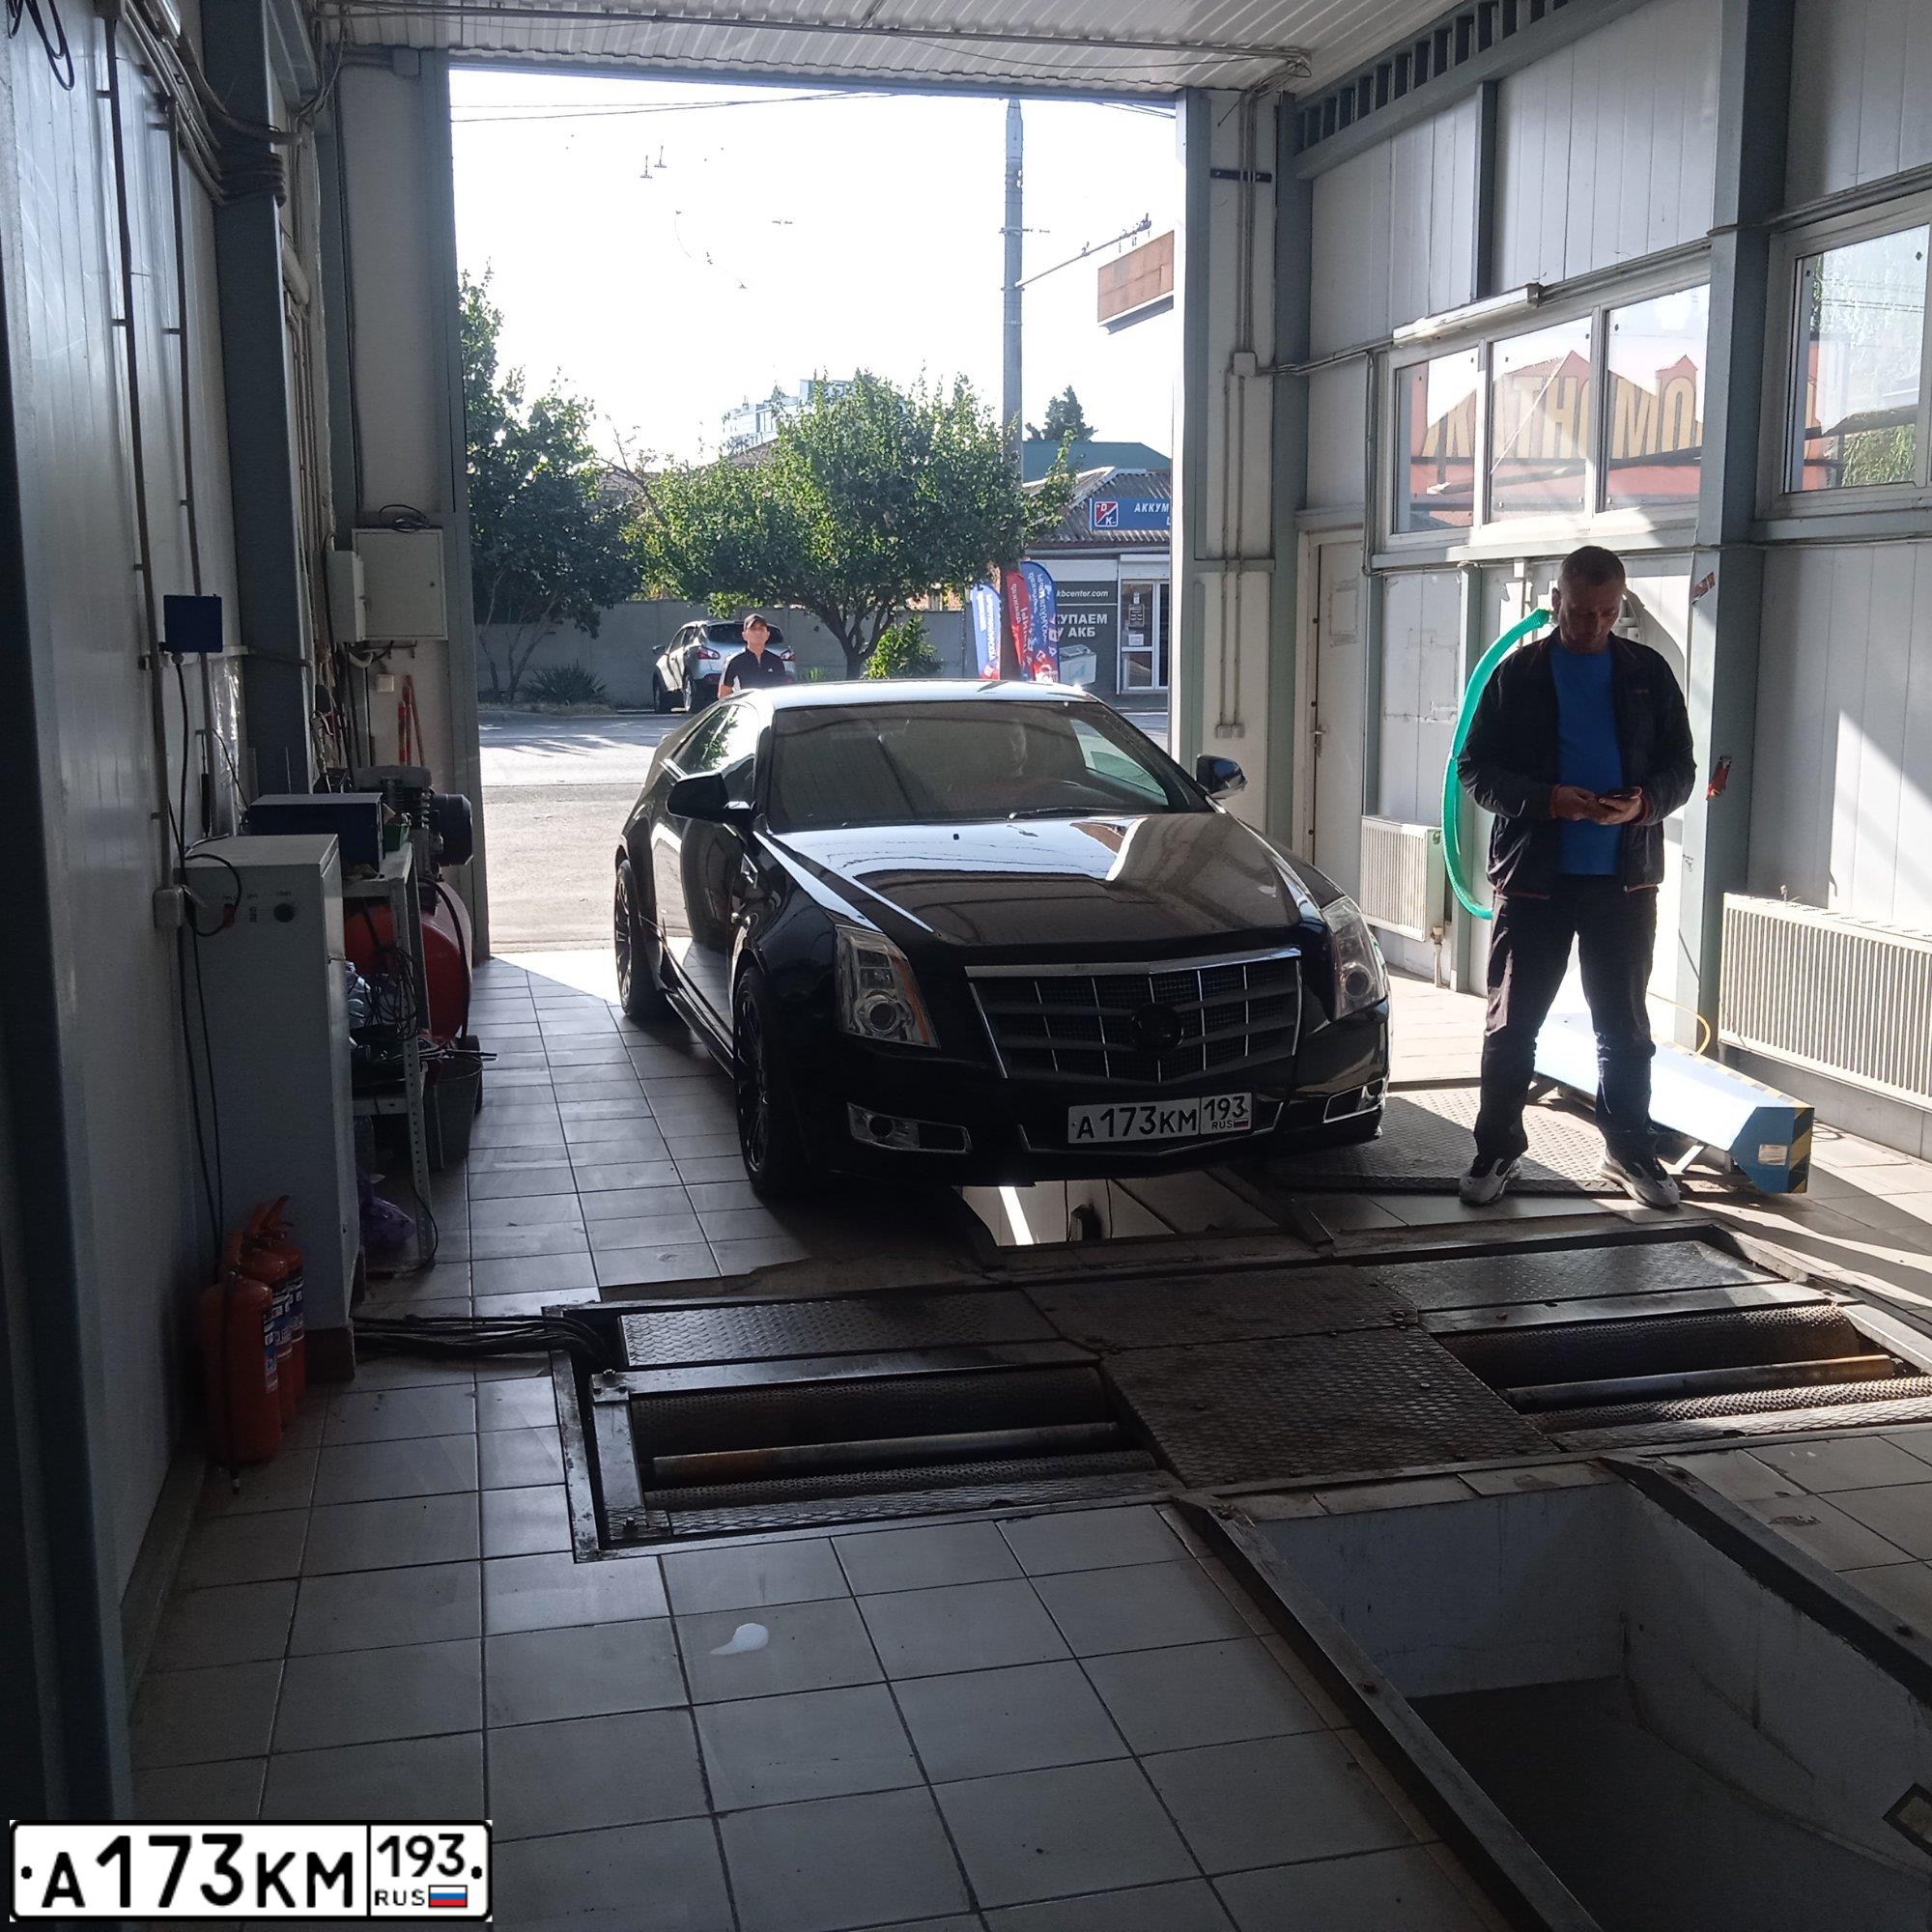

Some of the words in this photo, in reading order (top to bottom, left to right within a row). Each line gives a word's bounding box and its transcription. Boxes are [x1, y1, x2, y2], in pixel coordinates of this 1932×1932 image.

[1067, 627, 1095, 638] АКБ
[1204, 1094, 1245, 1122] 193
[1211, 1120, 1233, 1129] RUS
